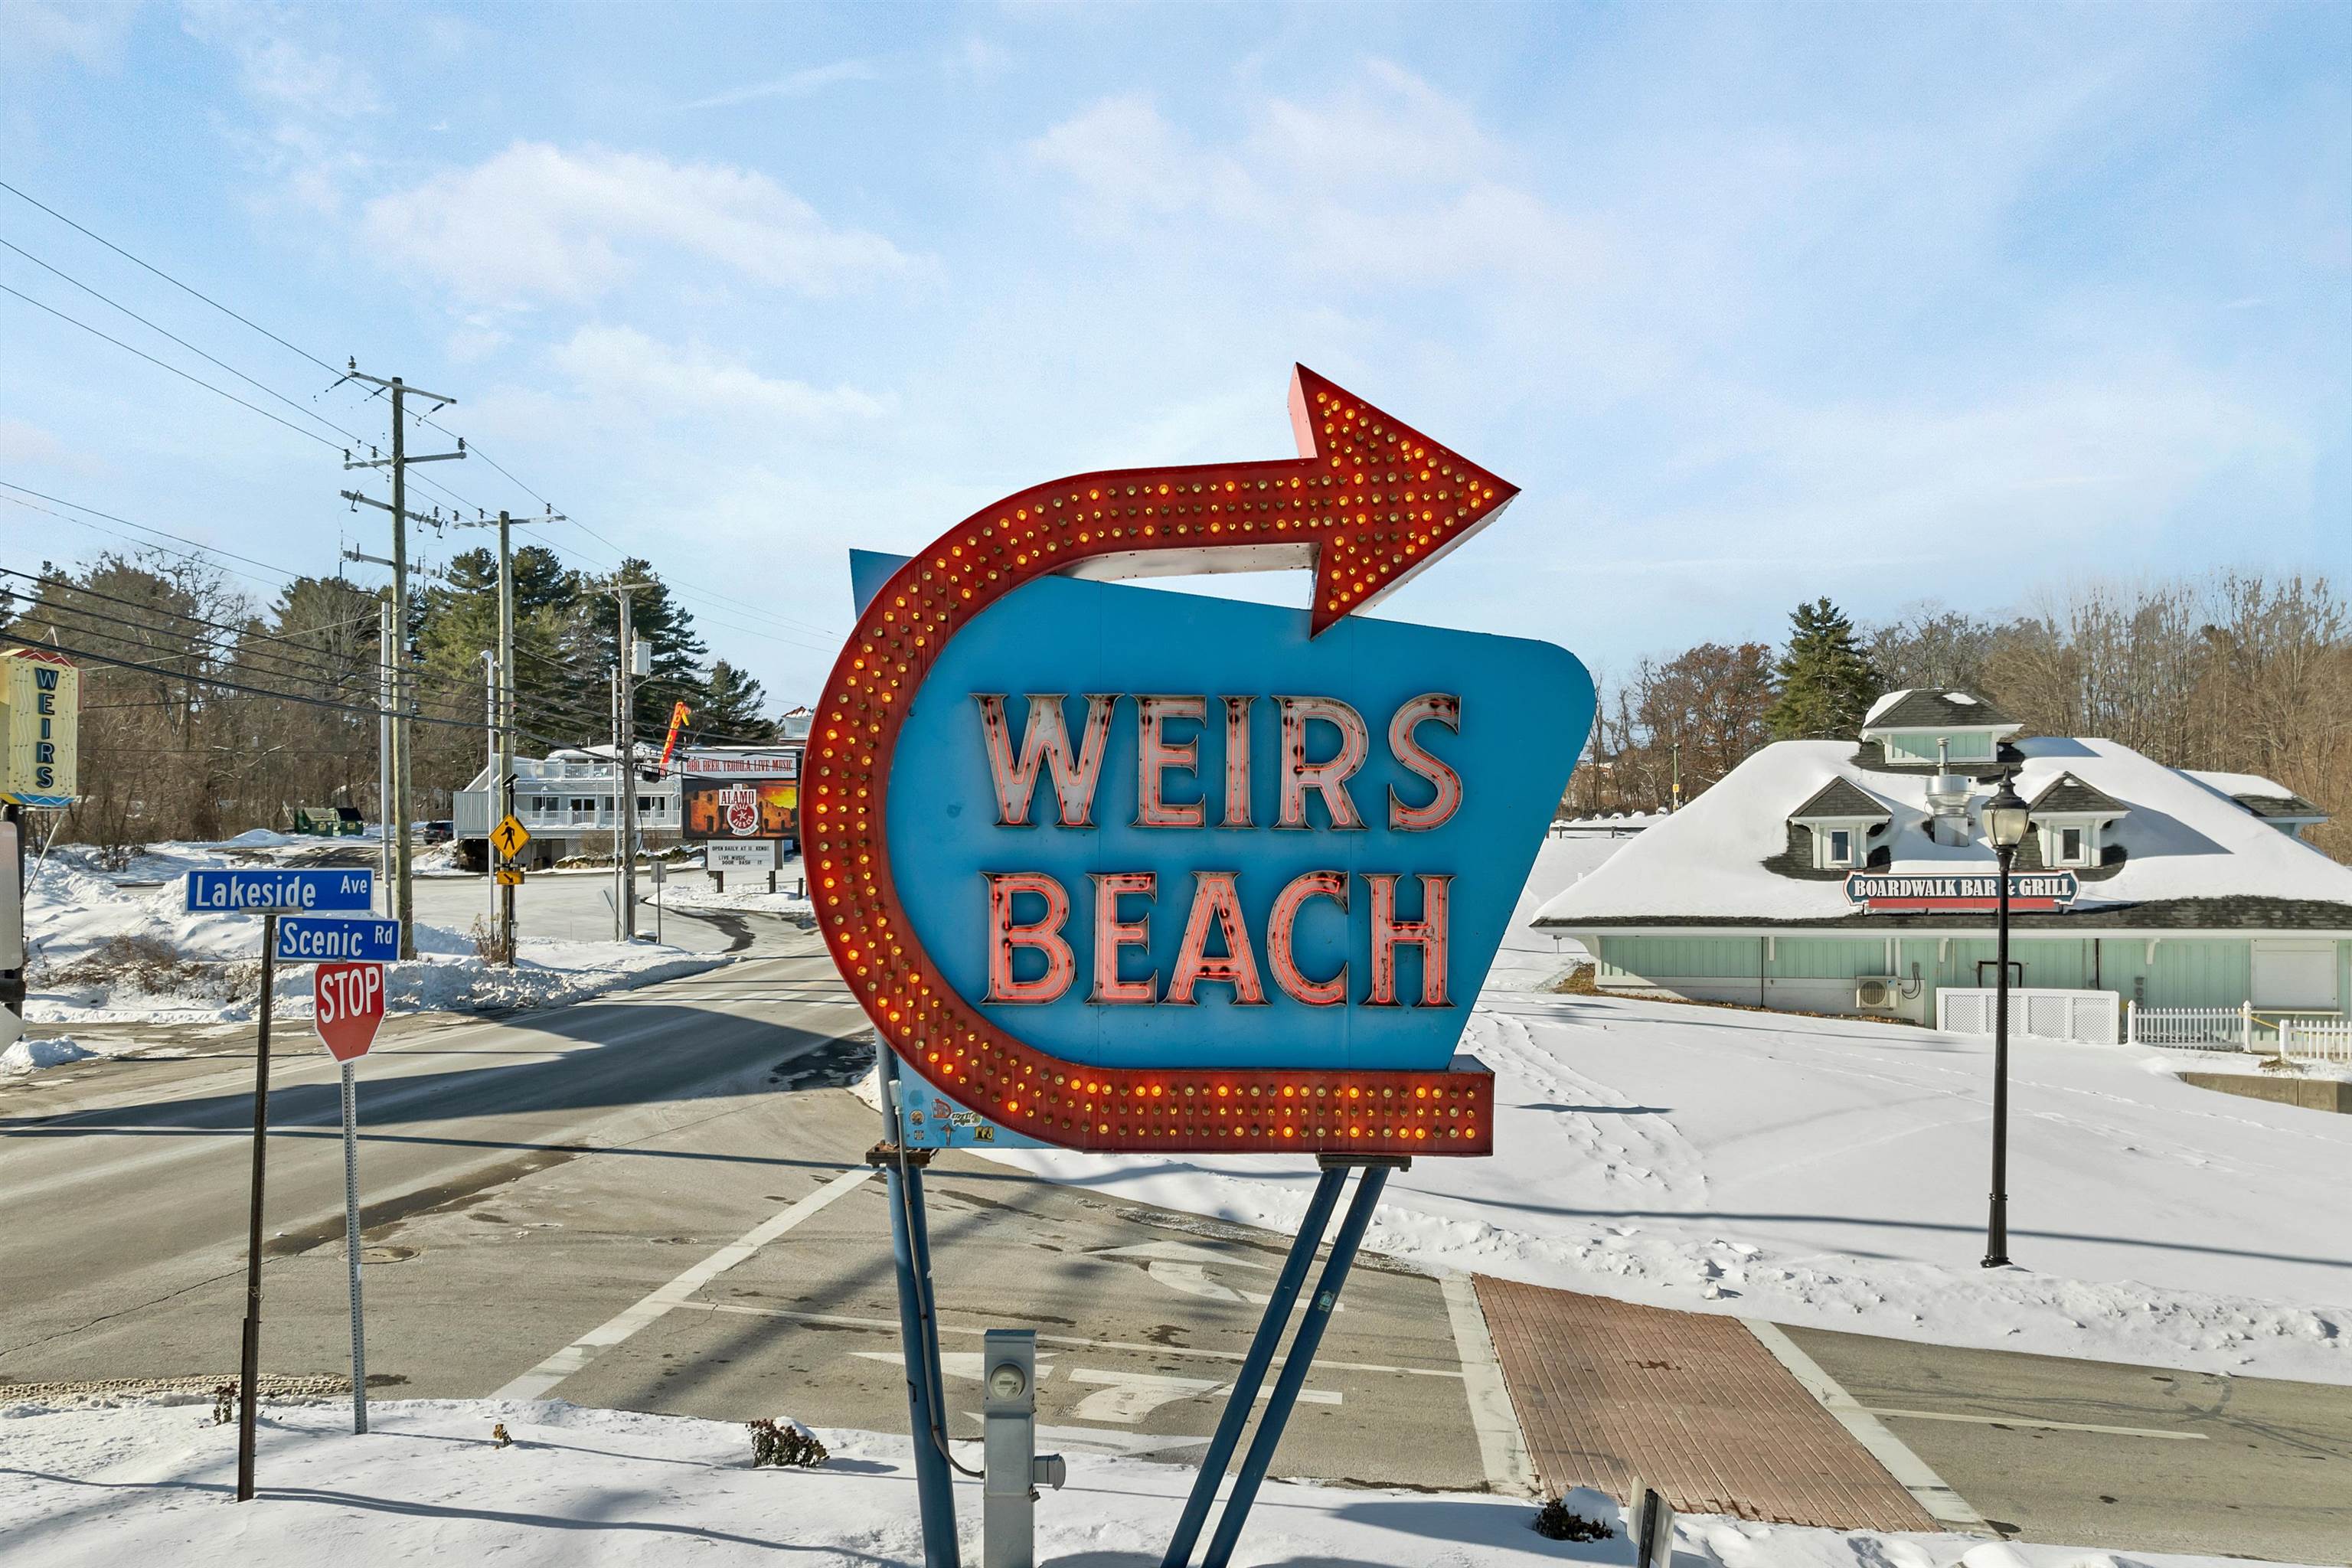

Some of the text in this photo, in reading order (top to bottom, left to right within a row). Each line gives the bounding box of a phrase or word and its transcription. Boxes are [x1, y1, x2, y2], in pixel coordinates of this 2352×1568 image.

[34, 668, 60, 789] WEIRS
[754, 760, 770, 772] LIVE
[772, 760, 793, 772] MUSIC
[969, 692, 1464, 832] WEIRS
[721, 790, 754, 805] ALAMO
[196, 875, 368, 907] Lakeside Ave
[1854, 879, 1956, 897] BOARDWALK
[1961, 880, 1997, 897] BAR
[2019, 879, 2071, 897] GRILL
[283, 922, 394, 957] Scenic Rd
[979, 870, 1458, 1008] BEACH
[320, 966, 381, 1024] STOP
